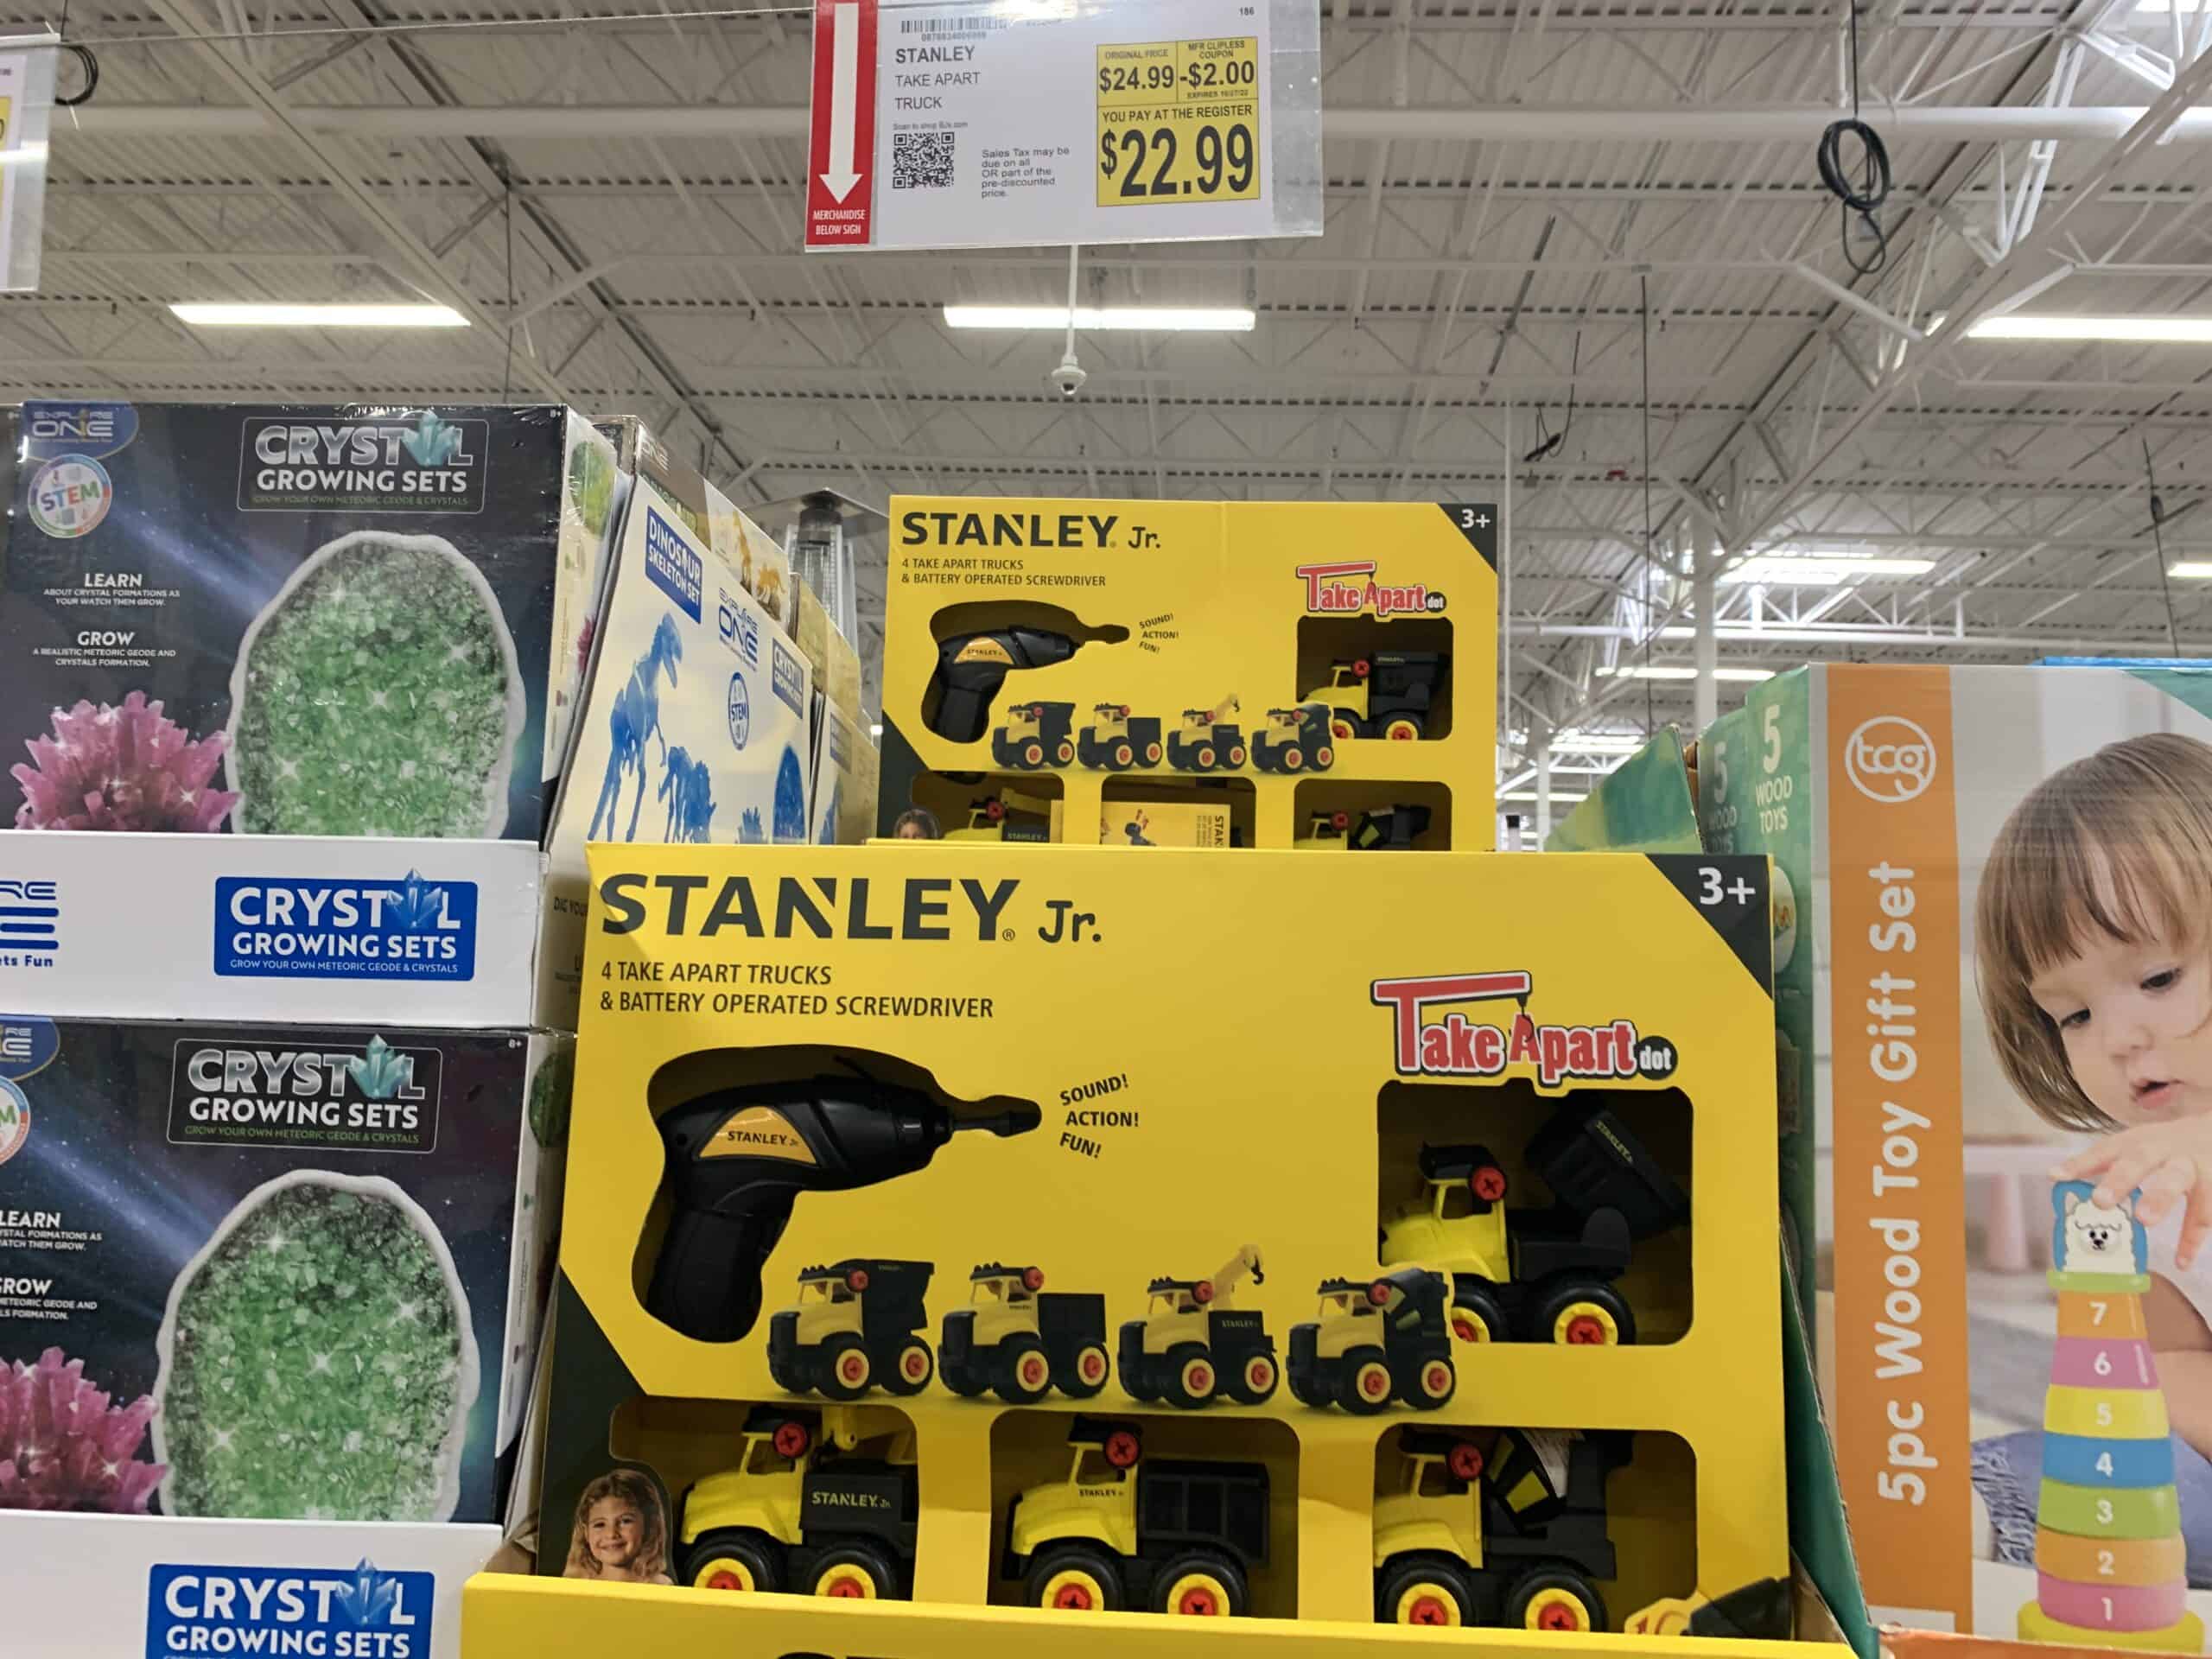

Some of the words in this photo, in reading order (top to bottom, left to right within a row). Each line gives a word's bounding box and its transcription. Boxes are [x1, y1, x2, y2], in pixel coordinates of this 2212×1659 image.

[1239, 7, 1255, 16] 186
[895, 45, 976, 63] STANLEY
[1105, 50, 1142, 60] ORIGINAL
[1145, 48, 1168, 58] PRICE
[1188, 42, 1206, 51] MFR
[1207, 40, 1245, 50] CLIPLESS
[1199, 51, 1234, 60] COUPON
[895, 73, 931, 87] TAKE
[935, 72, 981, 86] APART
[1099, 64, 1174, 94] $24.99
[1179, 60, 1255, 89] -$2.00
[894, 96, 943, 111] TRUCK
[1103, 111, 1125, 123] YOU
[1128, 110, 1151, 122] PAY
[1154, 109, 1168, 120] AT
[1172, 107, 1193, 119] THE
[1197, 105, 1252, 118] REGISTER
[982, 149, 1009, 159] Sales
[1014, 148, 1029, 156] Tax
[1033, 149, 1053, 158] may
[1057, 147, 1070, 156] be
[1101, 124, 1253, 197] $22.99
[982, 159, 1000, 168] due
[1019, 158, 1030, 167] all
[982, 169, 998, 178] OR
[1001, 169, 1020, 179] part
[1023, 168, 1033, 176] of
[1036, 167, 1052, 176] the
[982, 177, 1055, 189] pre-discounted
[982, 189, 1007, 199] price.
[813, 209, 866, 220] MERCHANDISE
[816, 225, 842, 235] BELOW
[842, 224, 861, 234] SIGN
[32, 420, 114, 437] ONE
[257, 469, 395, 492] GROWING
[402, 470, 467, 493] SETS
[41, 481, 100, 512] STEM
[1460, 508, 1491, 529] 3+
[901, 512, 1119, 548] STANLEY
[1128, 526, 1161, 549] Jr.
[901, 558, 909, 569] 4
[912, 558, 939, 569] TAKE
[943, 559, 977, 569] APART
[981, 559, 1024, 570] TRUCKS
[84, 573, 143, 588] LEARN
[649, 544, 687, 594] SKELETON
[687, 582, 700, 606] SET
[901, 574, 909, 583] &
[913, 574, 961, 585] BATTERY
[964, 575, 1022, 585] OPERATED
[1026, 575, 1106, 587] SCREWDRIVER
[1297, 561, 1376, 613] Take
[1363, 580, 1427, 616] Apart
[1427, 595, 1444, 608] dot
[137, 598, 166, 607] GROW.
[1139, 613, 1174, 629] SOUND!
[77, 631, 136, 645] GROW
[719, 605, 758, 664] ONE
[1141, 631, 1179, 640] ACTION!
[1139, 641, 1160, 654] FUN!
[99, 658, 150, 667] FORMATION.
[731, 703, 747, 721] STEM
[1763, 704, 1781, 773] 5
[1713, 741, 1727, 804] 5
[1755, 775, 1793, 807] WOOD
[1760, 805, 1789, 835] TOYS
[1698, 867, 1756, 906] 3+
[599, 873, 1020, 941] STANLEY
[1038, 899, 1102, 944] Jr.
[1868, 861, 1916, 952] Set
[232, 932, 380, 957] GROWING
[387, 935, 457, 959] SETS
[25, 955, 53, 967] Fun
[230, 959, 260, 968] GROW
[263, 960, 289, 969] YOUR
[291, 961, 315, 969] OWN
[318, 962, 366, 971] METEORIC
[369, 963, 402, 972] GEODE
[404, 963, 410, 972] &
[412, 963, 458, 973] CRYSTALS
[601, 961, 612, 982] 4
[617, 961, 664, 982] TAKE
[669, 962, 741, 984] APART
[747, 963, 832, 985] TRUCKS
[600, 991, 614, 1011] &
[620, 991, 707, 1014] BATTERY
[713, 994, 828, 1015] OPERATED
[835, 995, 994, 1018] SCREWDRIVER
[1370, 969, 1532, 1077] Take
[1509, 1013, 1637, 1088] Apart
[1639, 1045, 1672, 1072] dot
[1866, 970, 1917, 1082] Gift
[1059, 1072, 1129, 1107] SOUND!
[189, 1096, 340, 1127] GROWING
[348, 1103, 418, 1128] SETS
[1065, 1109, 1139, 1128] ACTION!
[185, 1125, 216, 1135] GROW
[219, 1126, 247, 1136] YOUR
[247, 1127, 274, 1138] OWN
[275, 1128, 326, 1141] METEORIC
[327, 1131, 361, 1142] GEODE
[371, 1132, 419, 1144] CRYSTALS
[728, 1130, 787, 1145] STANLEY
[1059, 1132, 1103, 1159] FUN!
[1872, 1101, 1931, 1196] Toy
[0, 1211, 61, 1228] LEARN
[28, 1230, 87, 1241] FORMATIONS
[90, 1232, 103, 1241] AS
[28, 1240, 54, 1249] THEM
[54, 1241, 86, 1251] GROW.
[43, 1299, 76, 1309] GEODE
[76, 1300, 98, 1310] AND
[1869, 1217, 1923, 1379] Wood
[12, 1309, 69, 1320] FORMATION.
[2090, 1301, 2107, 1325] 7
[2094, 1352, 2112, 1376] 6
[2096, 1402, 2112, 1427] 5
[1878, 1400, 1938, 1505] 5pc
[2095, 1452, 2113, 1478] 4
[812, 1491, 878, 1507] STANLEY
[2096, 1500, 2113, 1523] 3
[2098, 1551, 2115, 1575] 2
[2102, 1597, 2113, 1621] 1
[166, 1625, 326, 1656] GROWING
[335, 1630, 410, 1658] SETS
